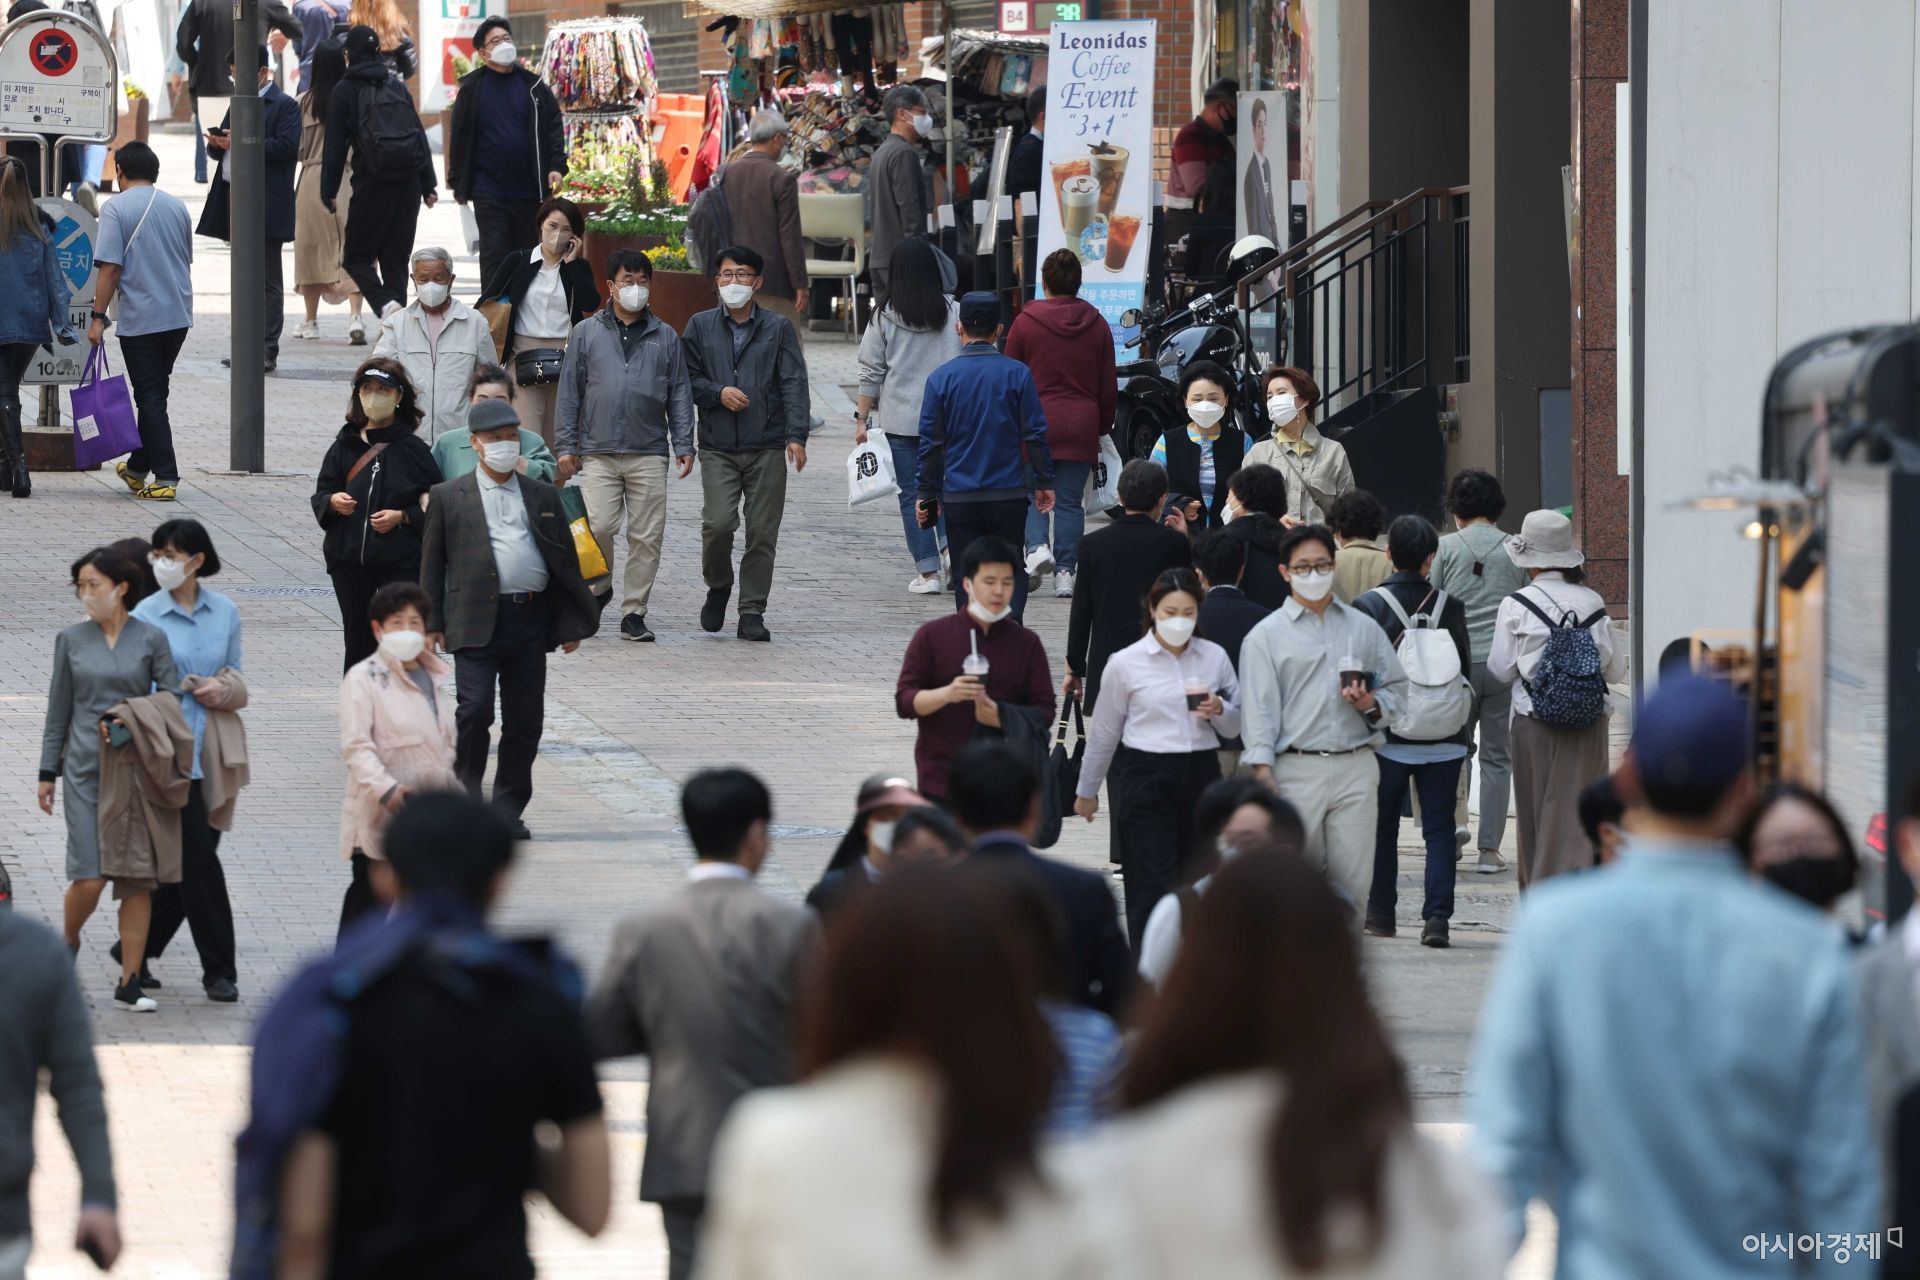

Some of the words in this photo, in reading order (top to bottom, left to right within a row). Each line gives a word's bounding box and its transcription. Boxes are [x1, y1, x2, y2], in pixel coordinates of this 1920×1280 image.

[1006, 10, 1023, 23] B4
[1060, 31, 1147, 49] Leonidas
[1072, 51, 1131, 81] Coffee
[4, 84, 11, 92] 이
[14, 85, 35, 94] 지역은
[81, 89, 101, 98] 구역이
[1061, 82, 1138, 109] Event
[4, 104, 10, 112] 및
[44, 107, 67, 116] 합니다.
[59, 252, 90, 271] 금지
[1099, 288, 1137, 301] 주문하면
[856, 452, 879, 481] 10
